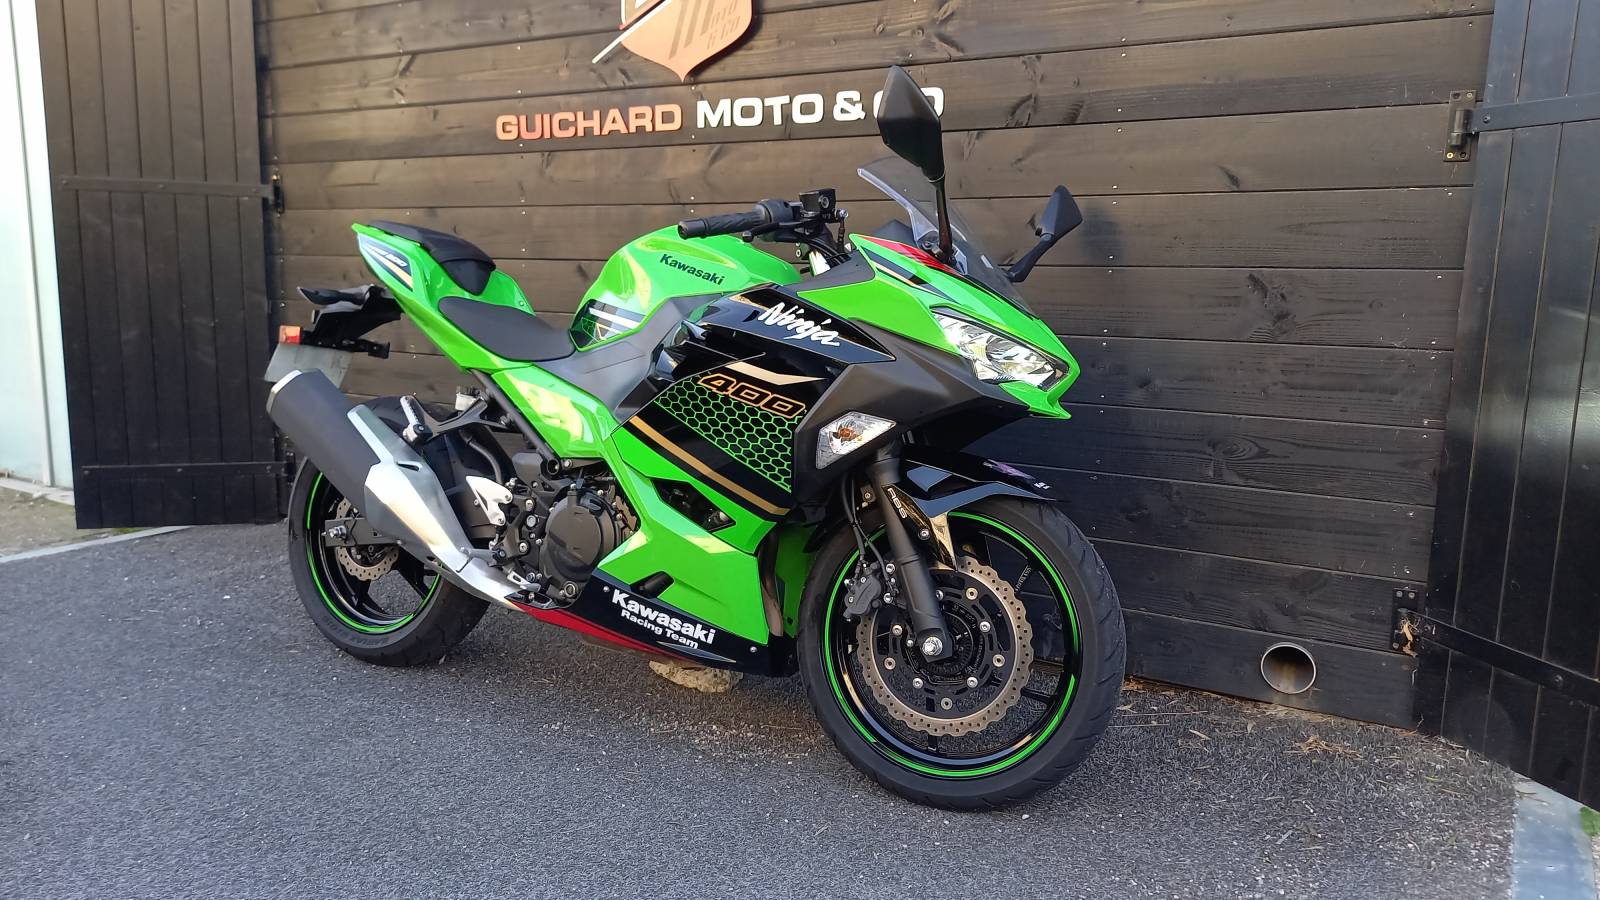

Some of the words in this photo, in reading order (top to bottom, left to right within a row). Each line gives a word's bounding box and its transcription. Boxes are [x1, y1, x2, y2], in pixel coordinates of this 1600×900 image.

[495, 103, 682, 141] GUICHARD
[696, 93, 824, 129] MOTO
[832, 90, 866, 122] &
[659, 253, 725, 286] Kawasaki
[758, 302, 841, 347] Ninja
[697, 373, 806, 418] 400
[887, 487, 908, 519] ABS
[611, 589, 716, 645] Kawasaki
[620, 609, 663, 635] Racing
[665, 628, 699, 650] Team
